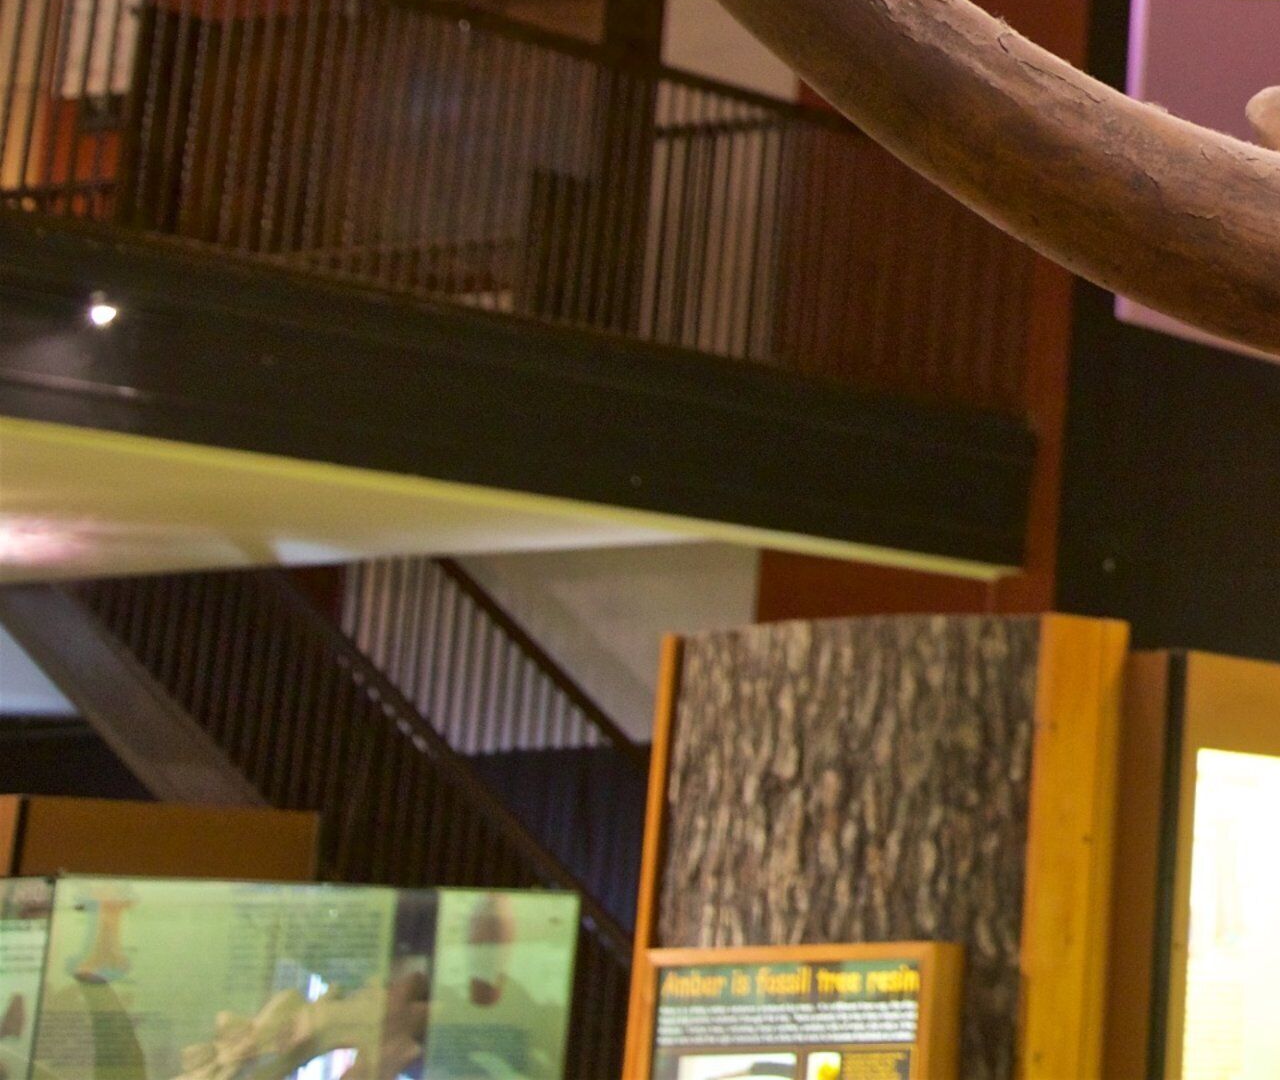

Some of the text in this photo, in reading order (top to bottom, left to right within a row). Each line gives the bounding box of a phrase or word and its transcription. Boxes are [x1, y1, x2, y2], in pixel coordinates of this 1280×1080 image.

[731, 968, 752, 996] is
[755, 965, 813, 1000] fossil
[816, 967, 862, 994] tree
[865, 963, 920, 996] resin
